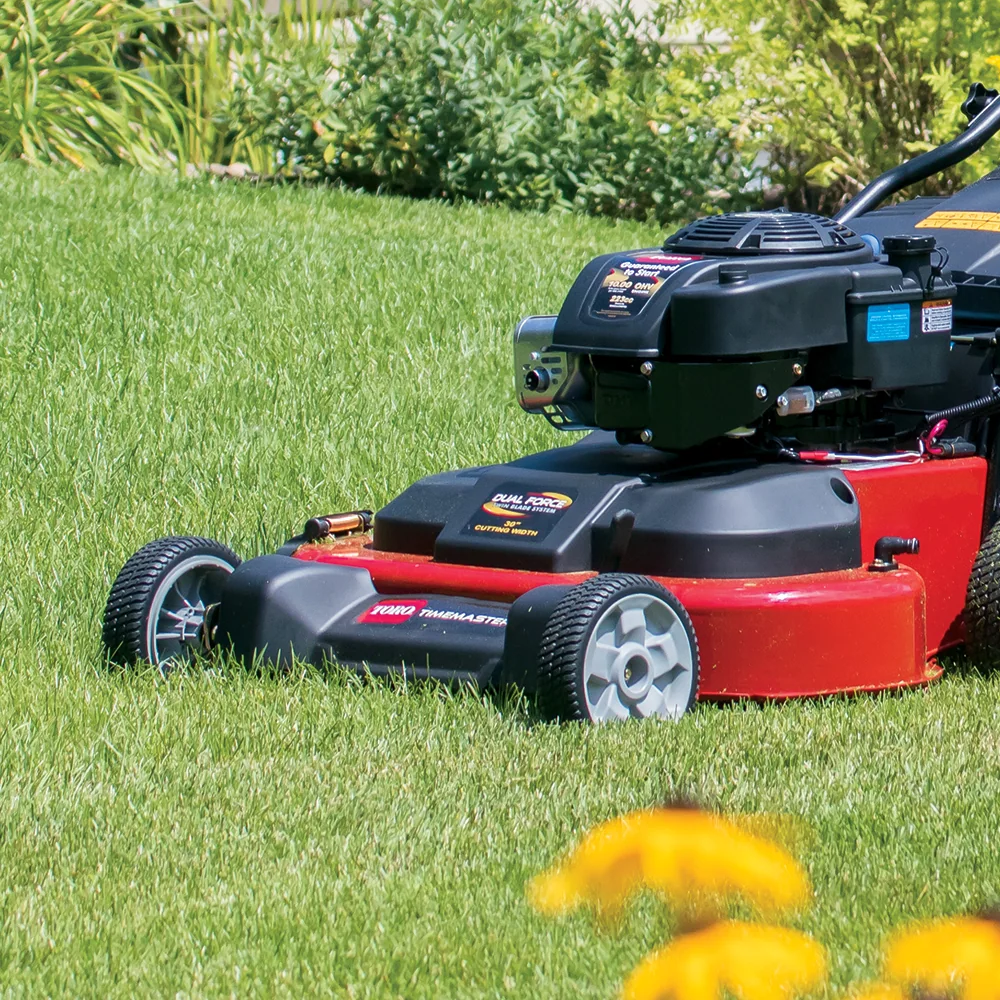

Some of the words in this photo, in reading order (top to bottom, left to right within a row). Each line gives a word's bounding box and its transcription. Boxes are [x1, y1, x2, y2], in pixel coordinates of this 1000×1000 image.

[620, 262, 679, 271] Guaranteed
[492, 493, 523, 503] DUAL
[525, 496, 567, 507] FORCE
[474, 525, 509, 533] CUTTING
[511, 528, 538, 536] WIDTH
[370, 605, 415, 615] TORO
